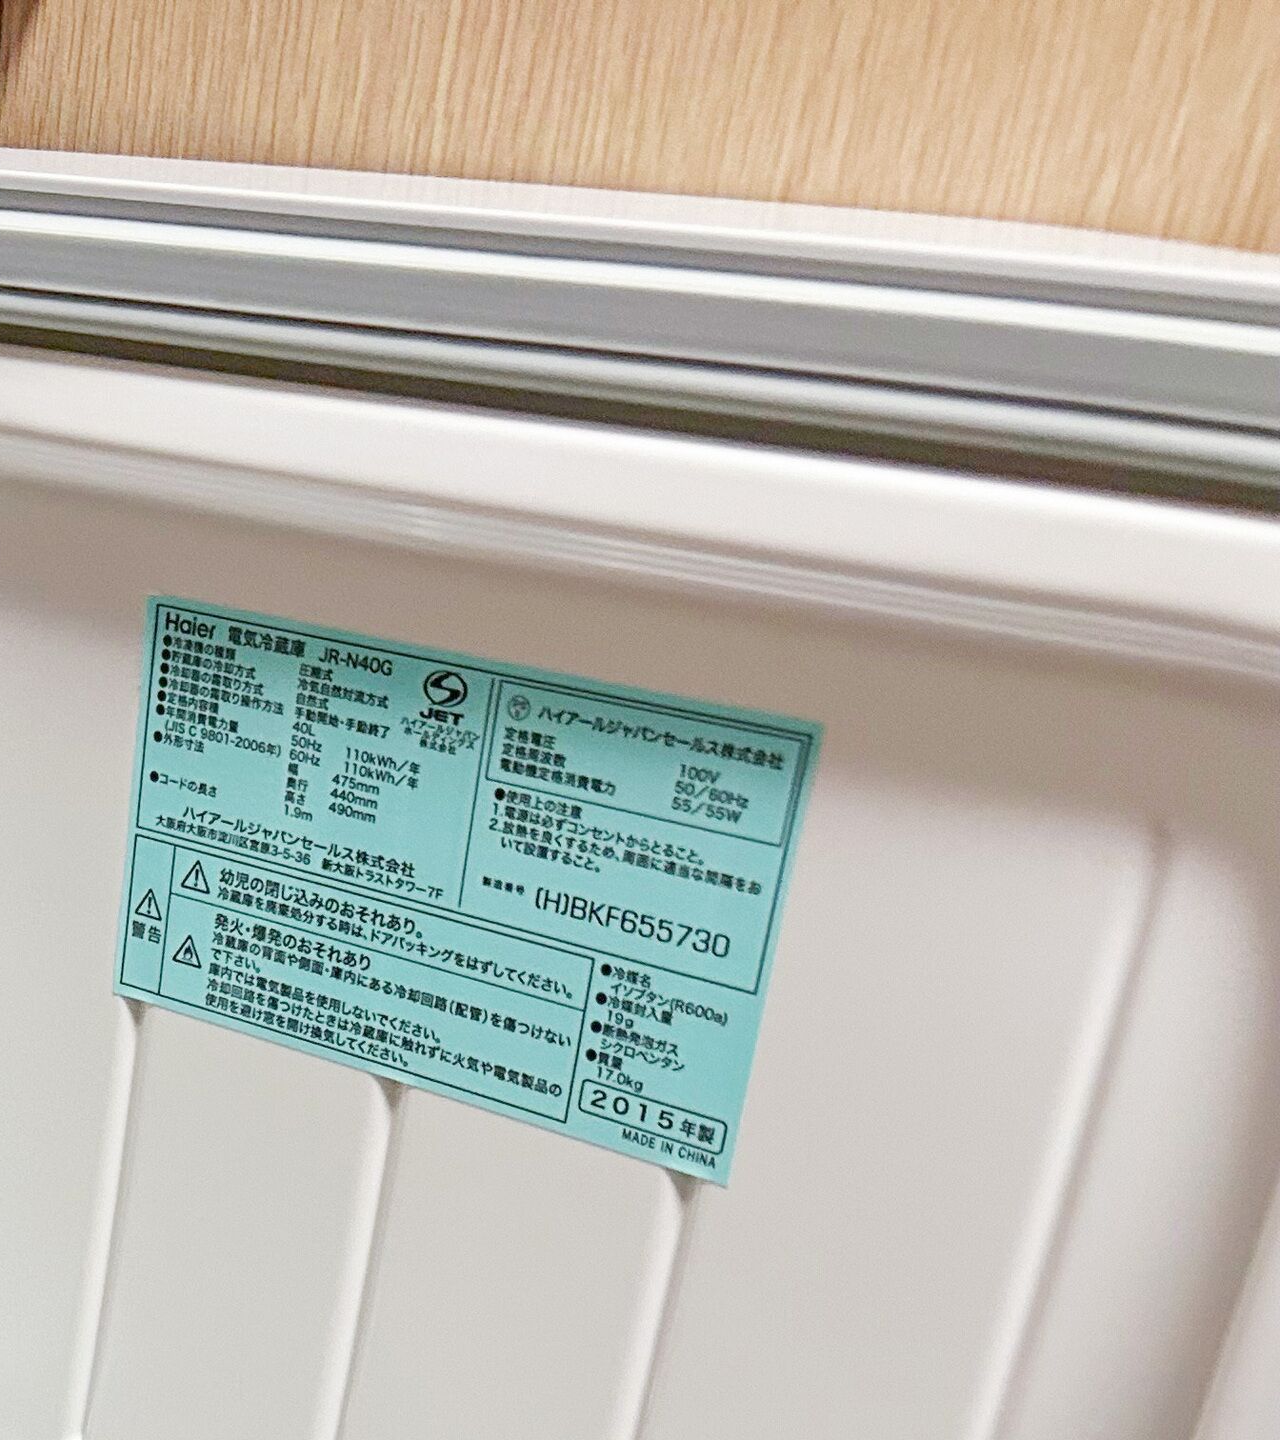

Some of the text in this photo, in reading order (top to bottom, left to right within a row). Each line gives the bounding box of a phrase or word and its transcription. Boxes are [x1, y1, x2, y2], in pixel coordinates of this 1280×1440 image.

[165, 612, 393, 677] Haier 電気冷蔵庫 JR-N40G
[292, 721, 315, 737] 40L
[419, 706, 465, 727] JET
[289, 749, 320, 767] 60Hz
[291, 735, 322, 753] 50Hz
[162, 731, 205, 754] 外形寸法
[332, 773, 380, 796] 475mm
[679, 763, 721, 785] 100V
[159, 771, 313, 823] コードの長さ 1.9m
[284, 789, 376, 824] 高さ 490mm
[330, 787, 378, 810] 440mm
[182, 806, 416, 879] ハイアールジャパンセールス株式会社
[219, 867, 423, 940] 幼児の閉じ込みのおそれあり。
[131, 919, 162, 944] 警告
[535, 887, 731, 959] (H)BKF655730
[214, 913, 371, 971] 発火・爆発のおそれあり
[607, 1009, 634, 1029] 19g
[597, 1066, 644, 1093] 17.0kg
[590, 1088, 716, 1145] 2015年製
[621, 1128, 717, 1169] MADE IN CHINA
